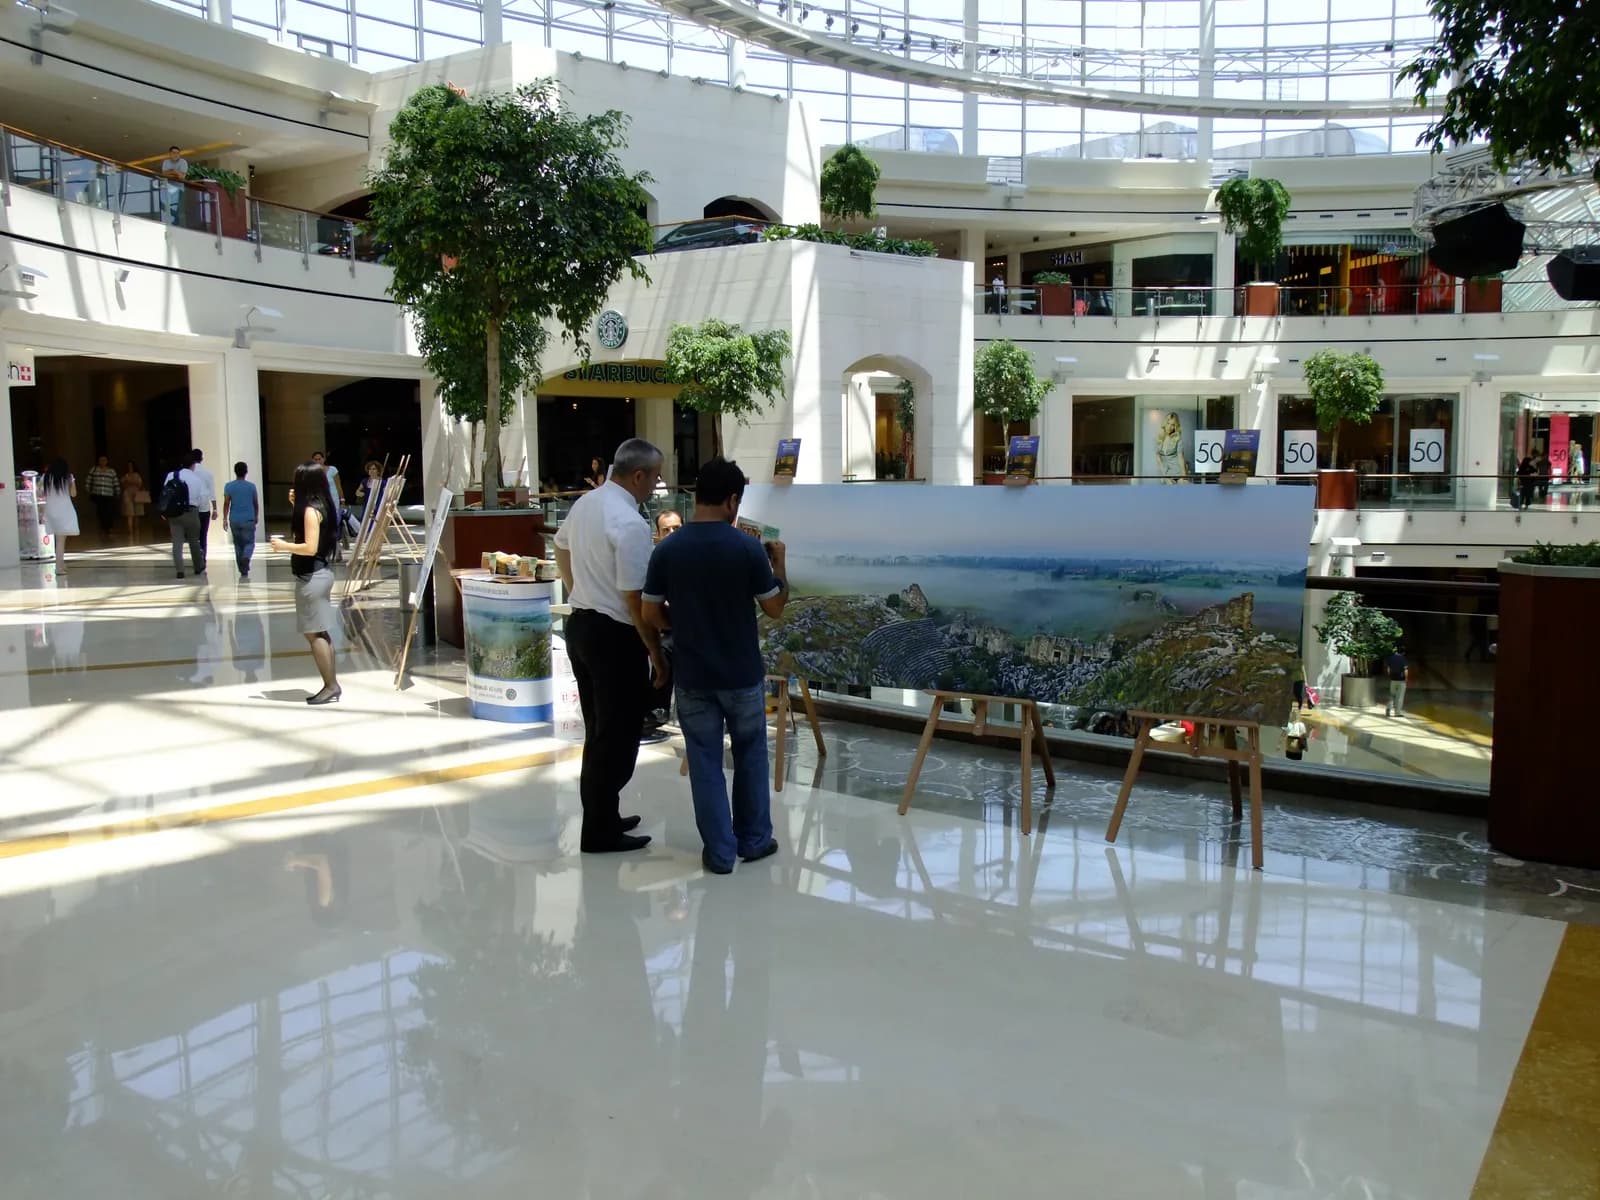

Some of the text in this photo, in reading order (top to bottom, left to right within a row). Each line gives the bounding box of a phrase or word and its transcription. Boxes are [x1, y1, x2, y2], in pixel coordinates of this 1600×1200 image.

[565, 363, 685, 385] STARBUC
[1196, 442, 1224, 464] 50
[1285, 442, 1315, 464] 50
[1411, 441, 1442, 463] 50
[1552, 449, 1567, 462] 50
